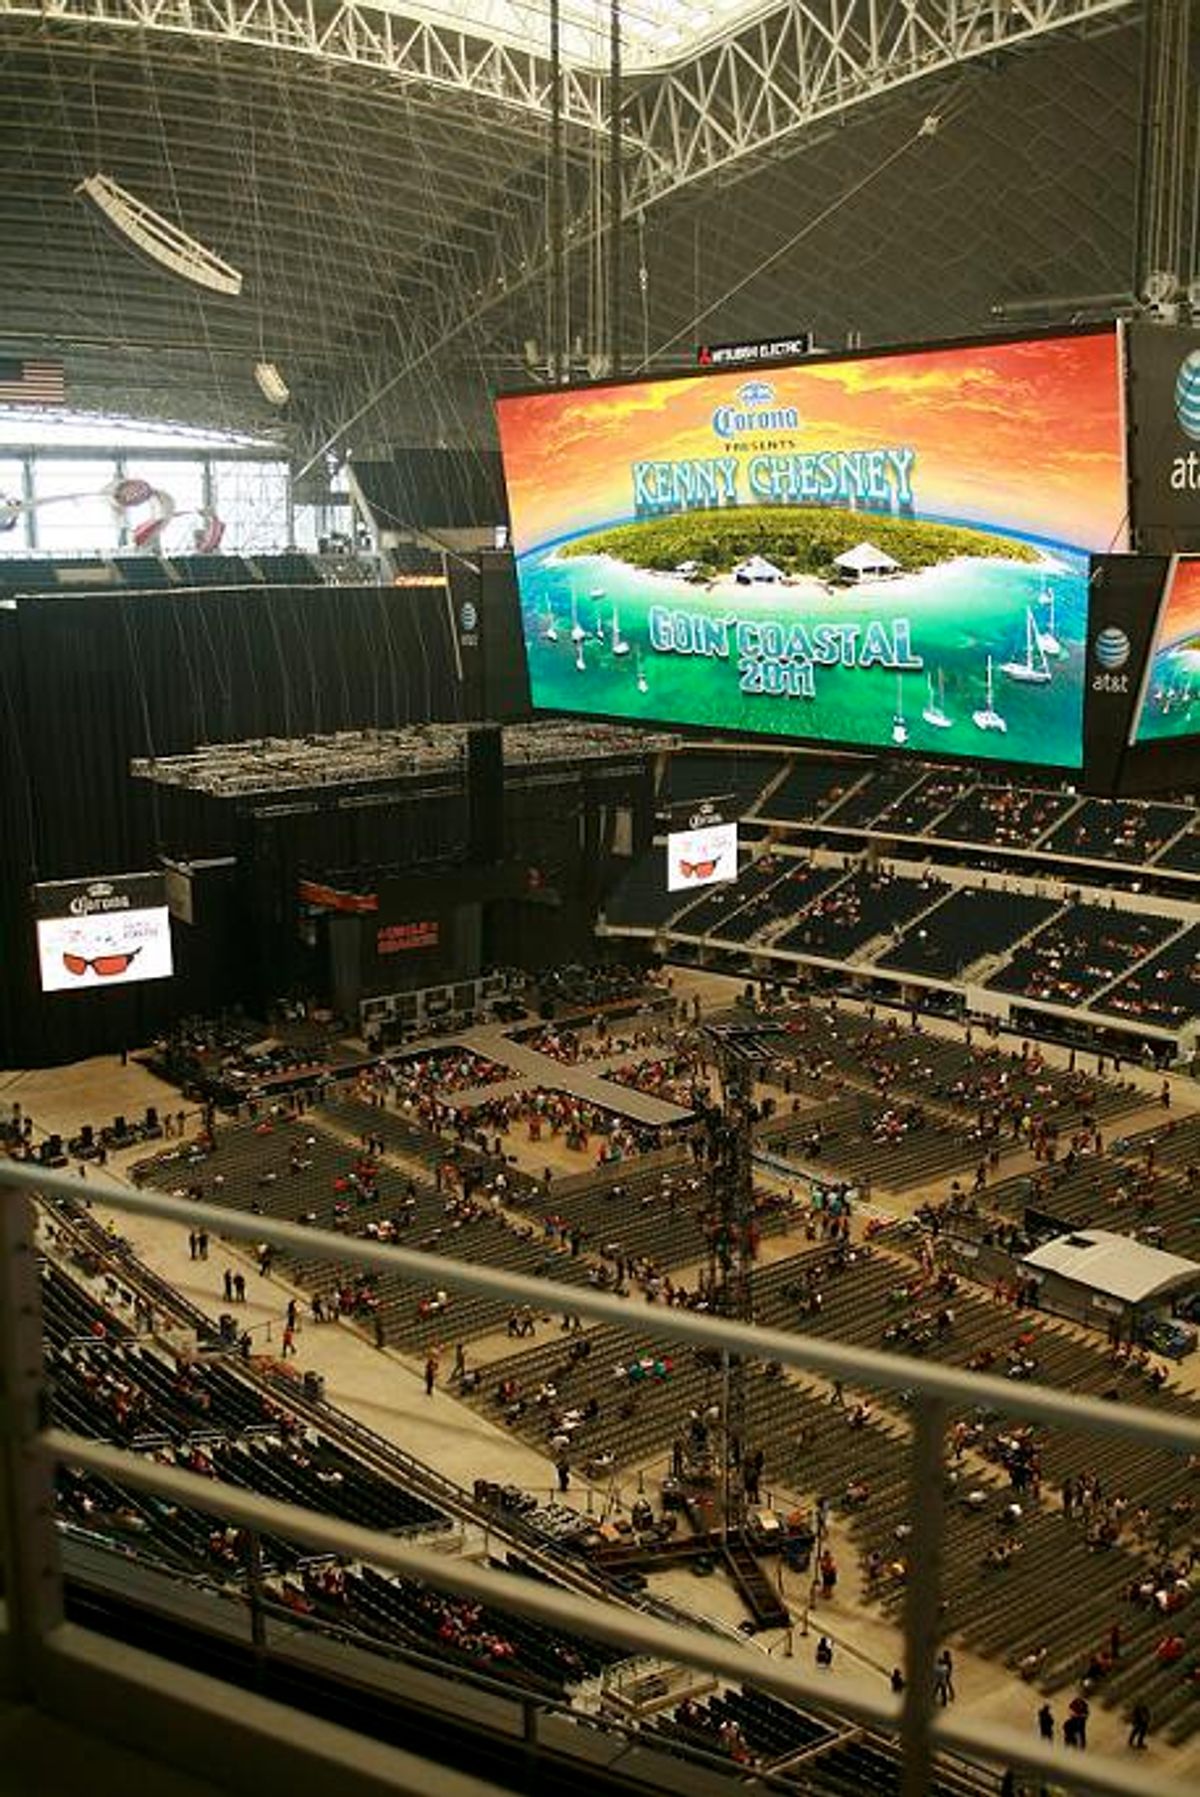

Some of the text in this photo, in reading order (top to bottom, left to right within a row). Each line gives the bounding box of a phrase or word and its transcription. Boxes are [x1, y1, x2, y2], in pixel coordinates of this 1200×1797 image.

[712, 406, 798, 438] Corona
[633, 448, 915, 507] KENNY CHESNEY
[736, 617, 923, 668] COASTAL
[738, 655, 816, 697] 2011
[1092, 673, 1128, 693] at&t
[70, 895, 130, 915] Corona
